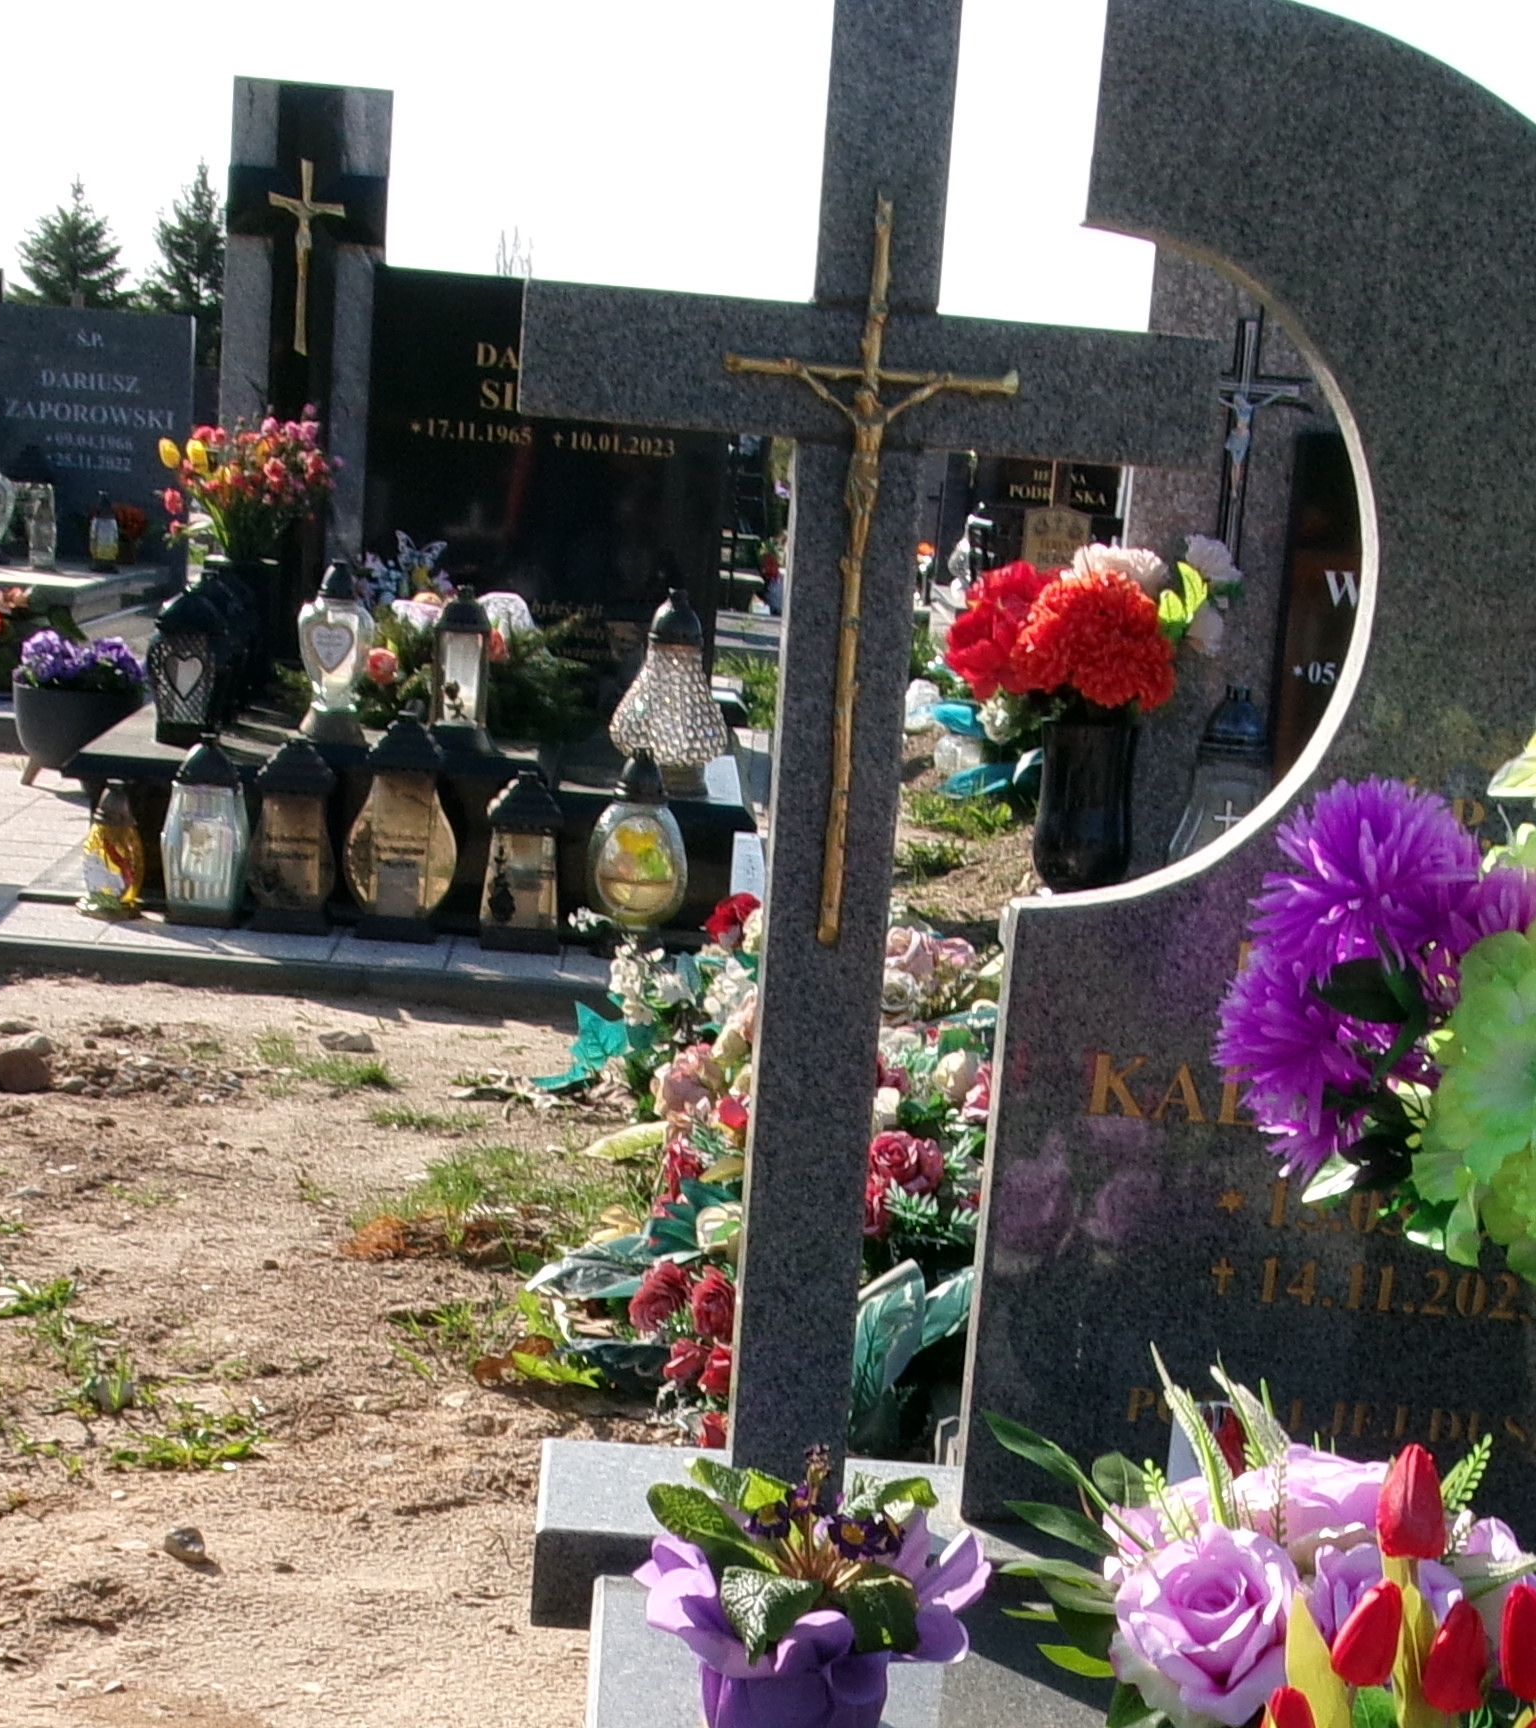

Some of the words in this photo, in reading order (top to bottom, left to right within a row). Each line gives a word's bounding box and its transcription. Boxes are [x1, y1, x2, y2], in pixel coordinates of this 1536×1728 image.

[40, 368, 142, 394] DARIUSZ
[4, 397, 175, 431] ZAPOROWSKI
[570, 430, 676, 458] 10.01.2023
